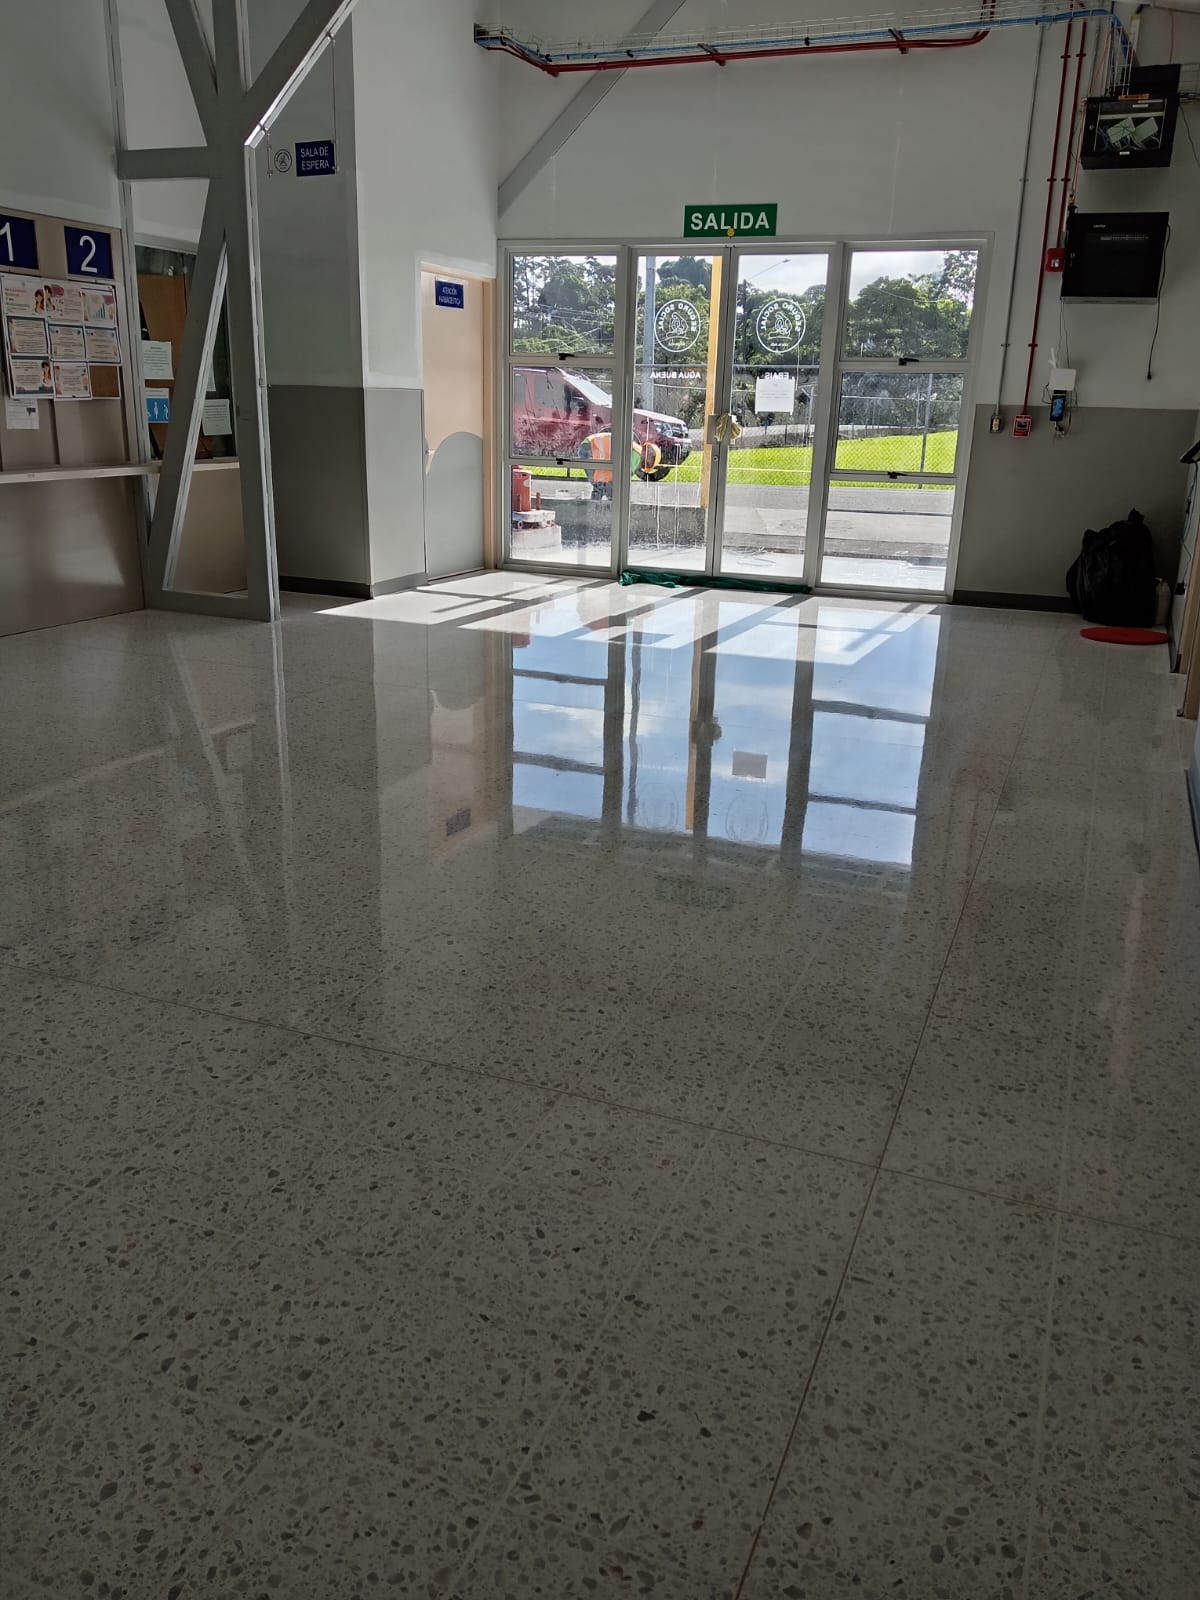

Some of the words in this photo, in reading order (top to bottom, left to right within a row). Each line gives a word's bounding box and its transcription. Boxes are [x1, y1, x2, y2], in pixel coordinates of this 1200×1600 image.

[300, 146, 319, 158] SALA
[319, 146, 329, 157] DE
[301, 159, 330, 170] ESPERA
[690, 211, 770, 231] SALIDA
[0, 222, 14, 262] 1
[79, 235, 98, 273] 2
